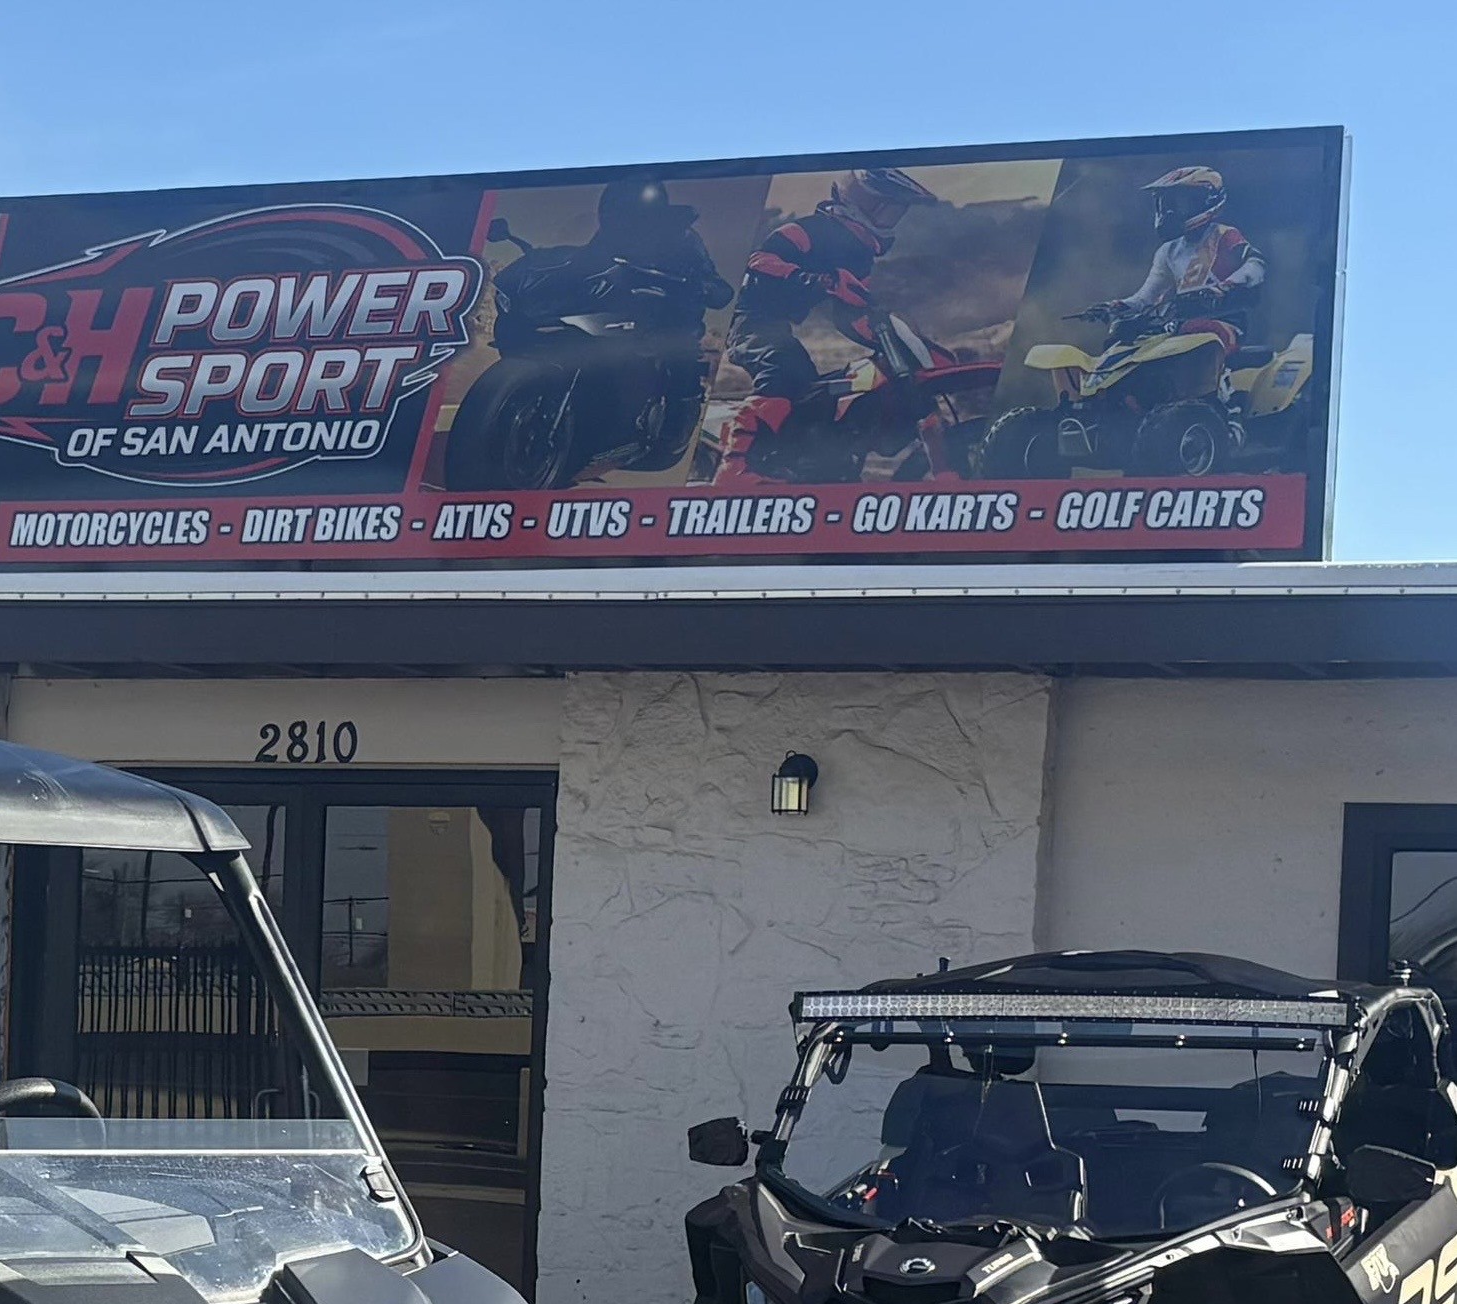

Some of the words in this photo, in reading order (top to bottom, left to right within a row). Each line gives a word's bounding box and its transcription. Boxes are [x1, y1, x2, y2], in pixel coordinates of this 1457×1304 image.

[153, 269, 465, 344] POWER
[130, 347, 417, 418] SPORT
[67, 428, 120, 457] OF
[124, 424, 201, 456] SAN
[207, 419, 381, 454] ANTONIO
[9, 510, 211, 547] MOTORCYCLES
[241, 508, 311, 544] DIRT
[312, 505, 399, 542] BIKES
[431, 504, 514, 540] ATVS
[545, 501, 630, 538] UTVS
[666, 498, 815, 536] TRAILERS
[851, 497, 899, 533] GO
[903, 493, 1018, 531] KARTS
[1055, 492, 1144, 530] GOLF
[1145, 489, 1264, 528] CARTS
[255, 720, 358, 763] 2810
